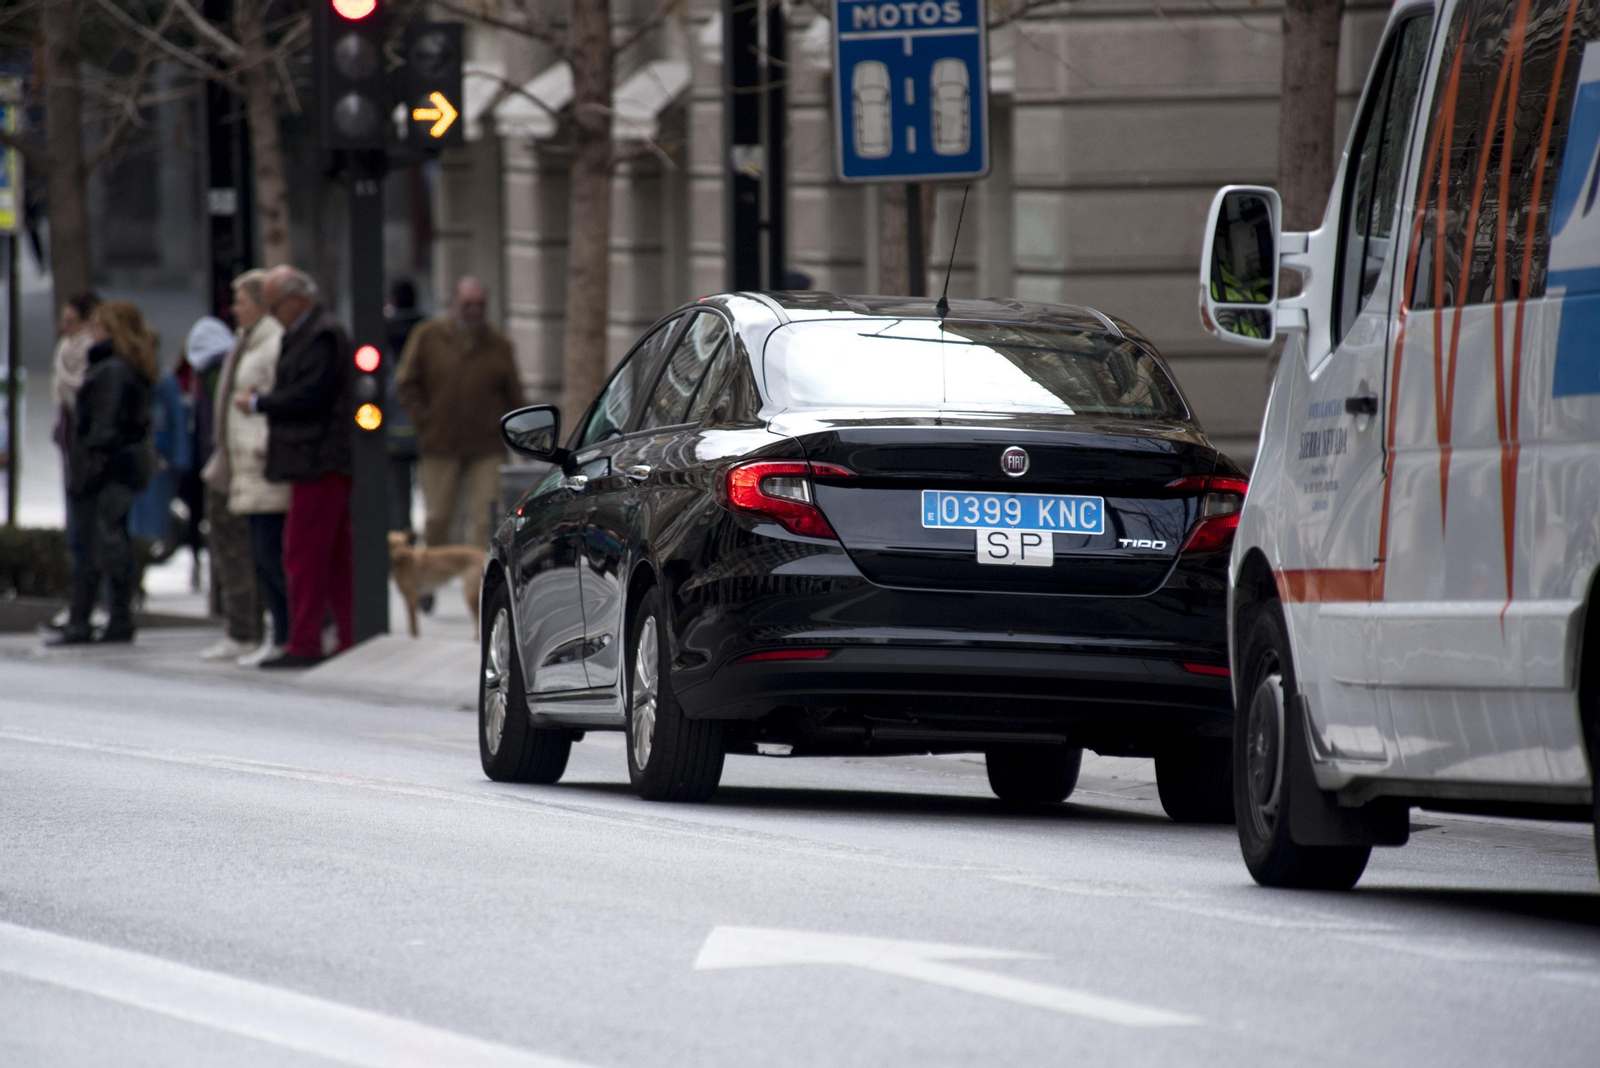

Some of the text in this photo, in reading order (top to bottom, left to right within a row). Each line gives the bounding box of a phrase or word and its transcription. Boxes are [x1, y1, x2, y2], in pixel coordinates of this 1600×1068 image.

[852, 1, 963, 29] MOTOS
[1299, 427, 1348, 460] SIERRA NEVADA
[1008, 455, 1024, 469] FIAT
[927, 512, 935, 521] E
[942, 495, 1097, 529] 0399 KNC
[1119, 538, 1167, 550] TIPO
